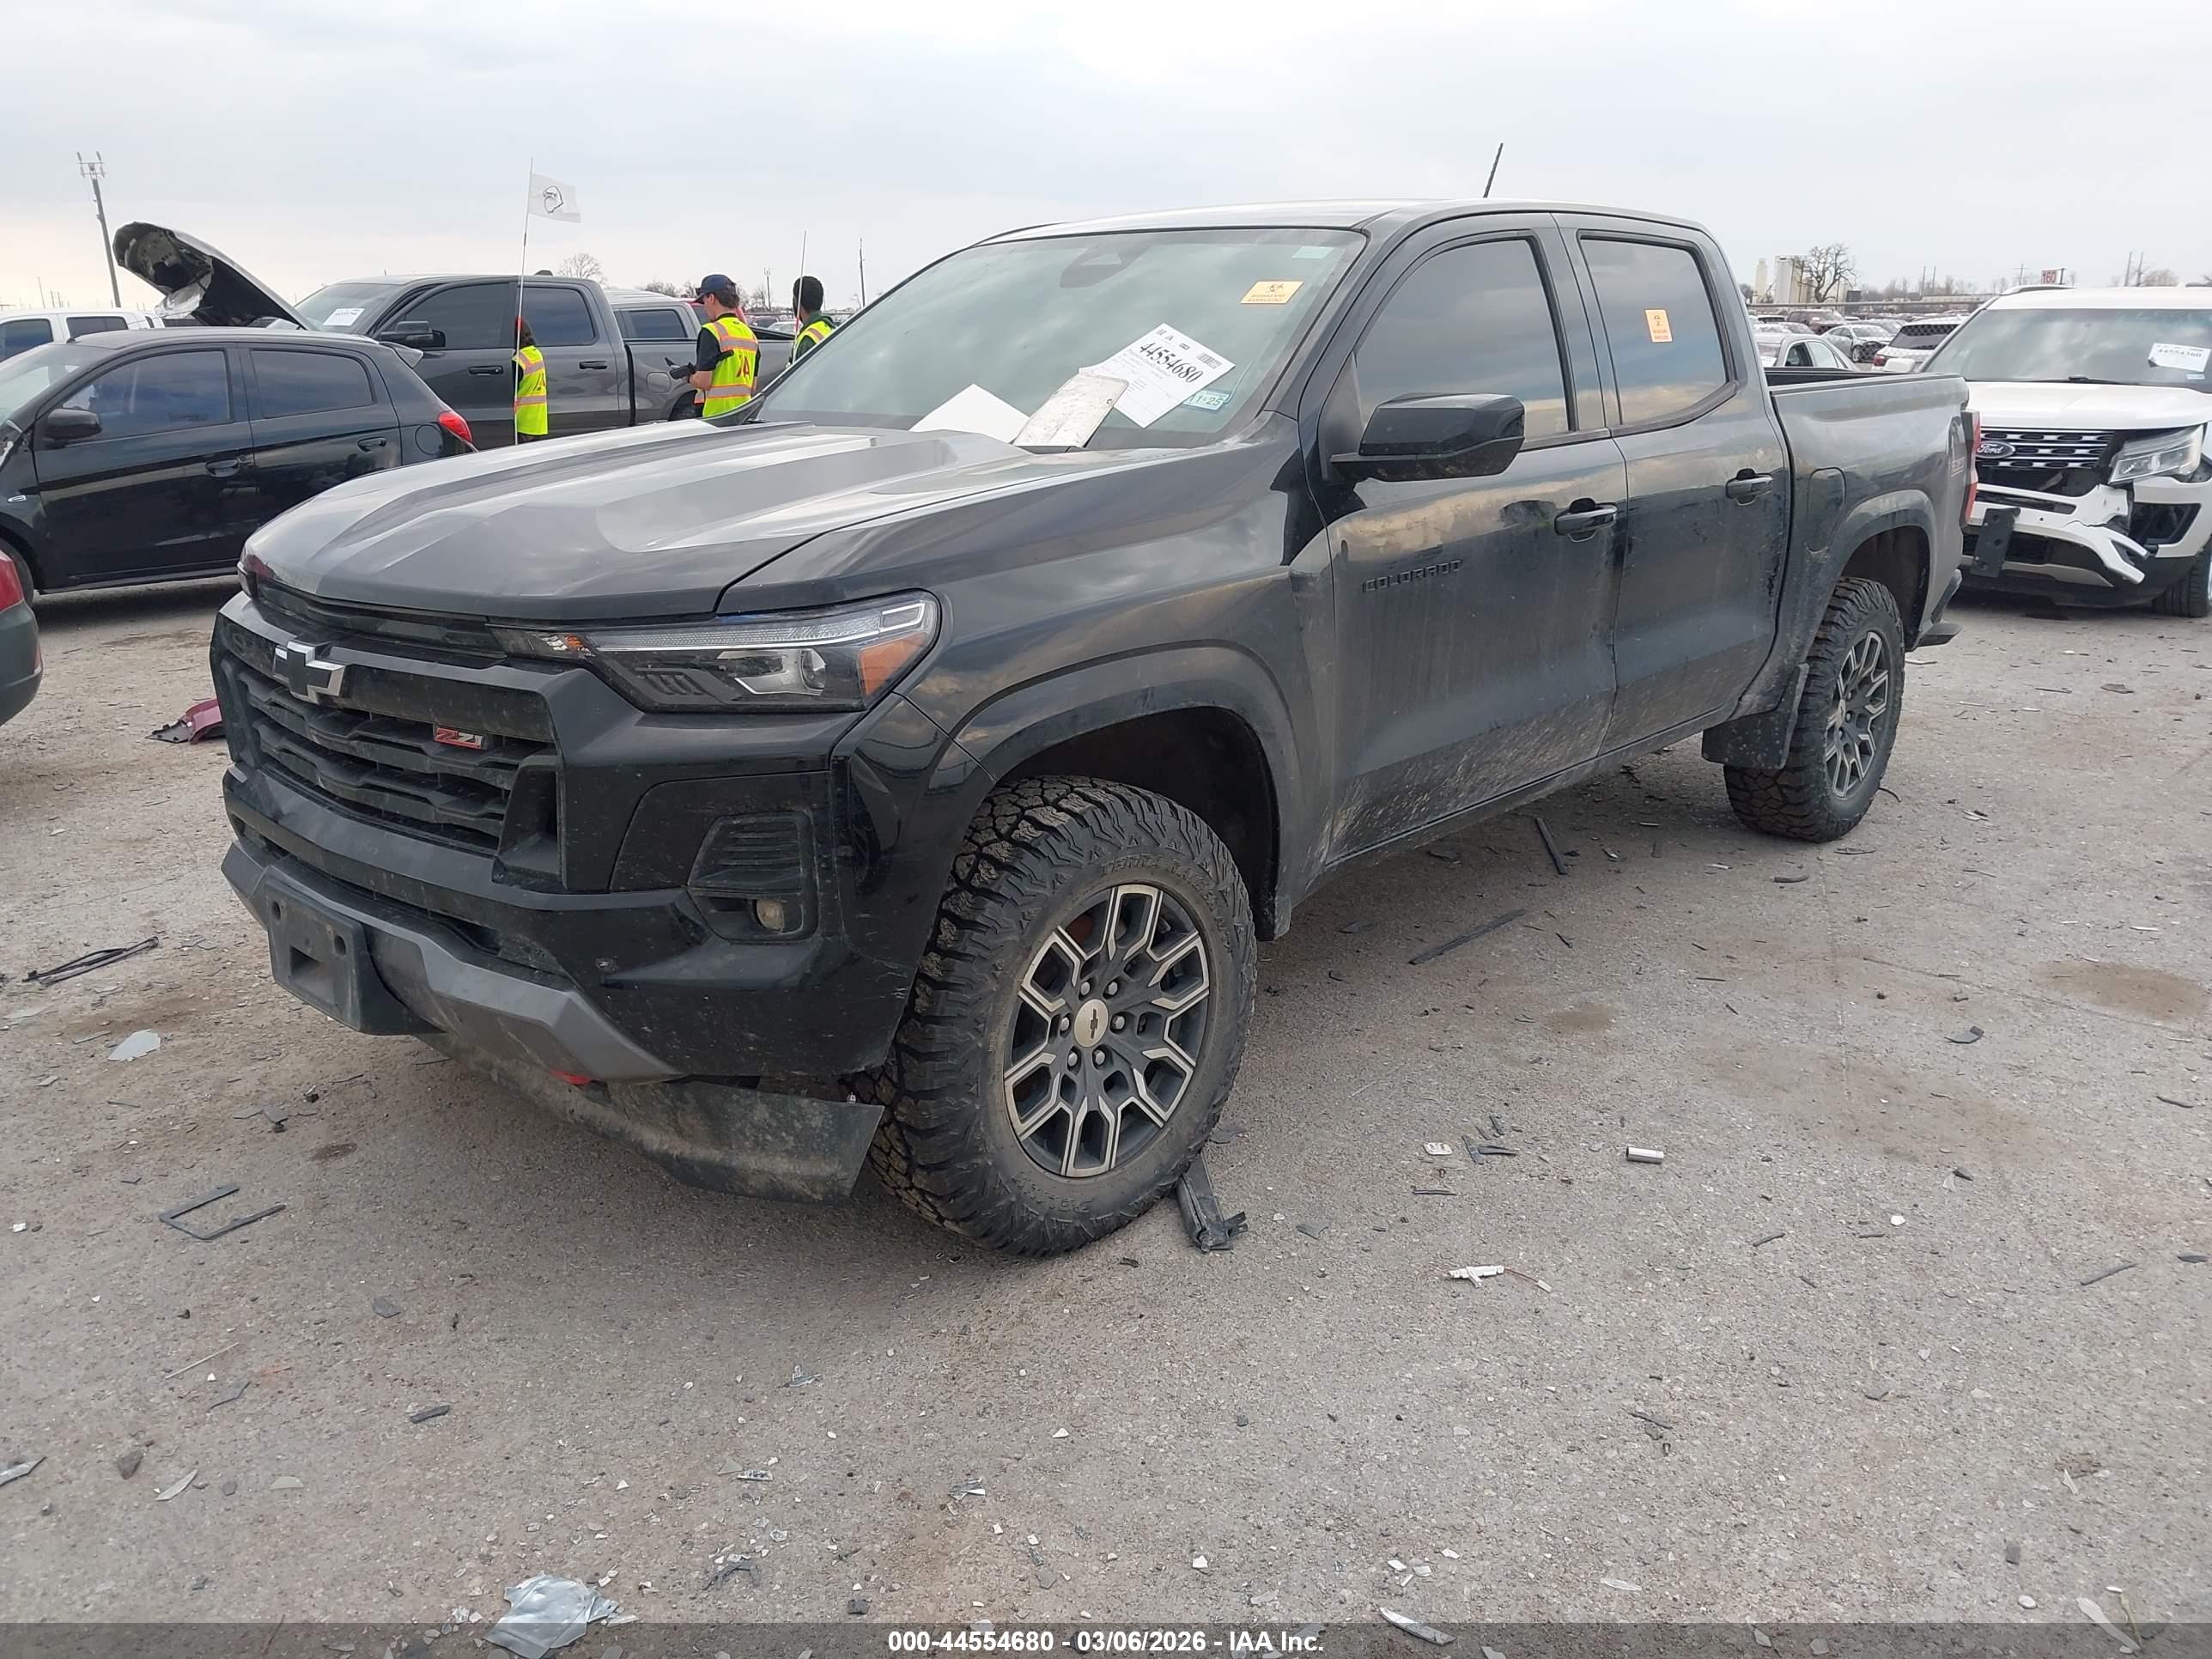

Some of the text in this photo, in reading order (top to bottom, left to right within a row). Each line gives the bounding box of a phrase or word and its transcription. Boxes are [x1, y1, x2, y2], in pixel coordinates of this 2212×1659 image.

[1139, 343, 1204, 383] 44554680
[1977, 443, 2004, 454] Ford
[1363, 559, 1462, 592] COLORADO
[435, 727, 483, 749] Z71
